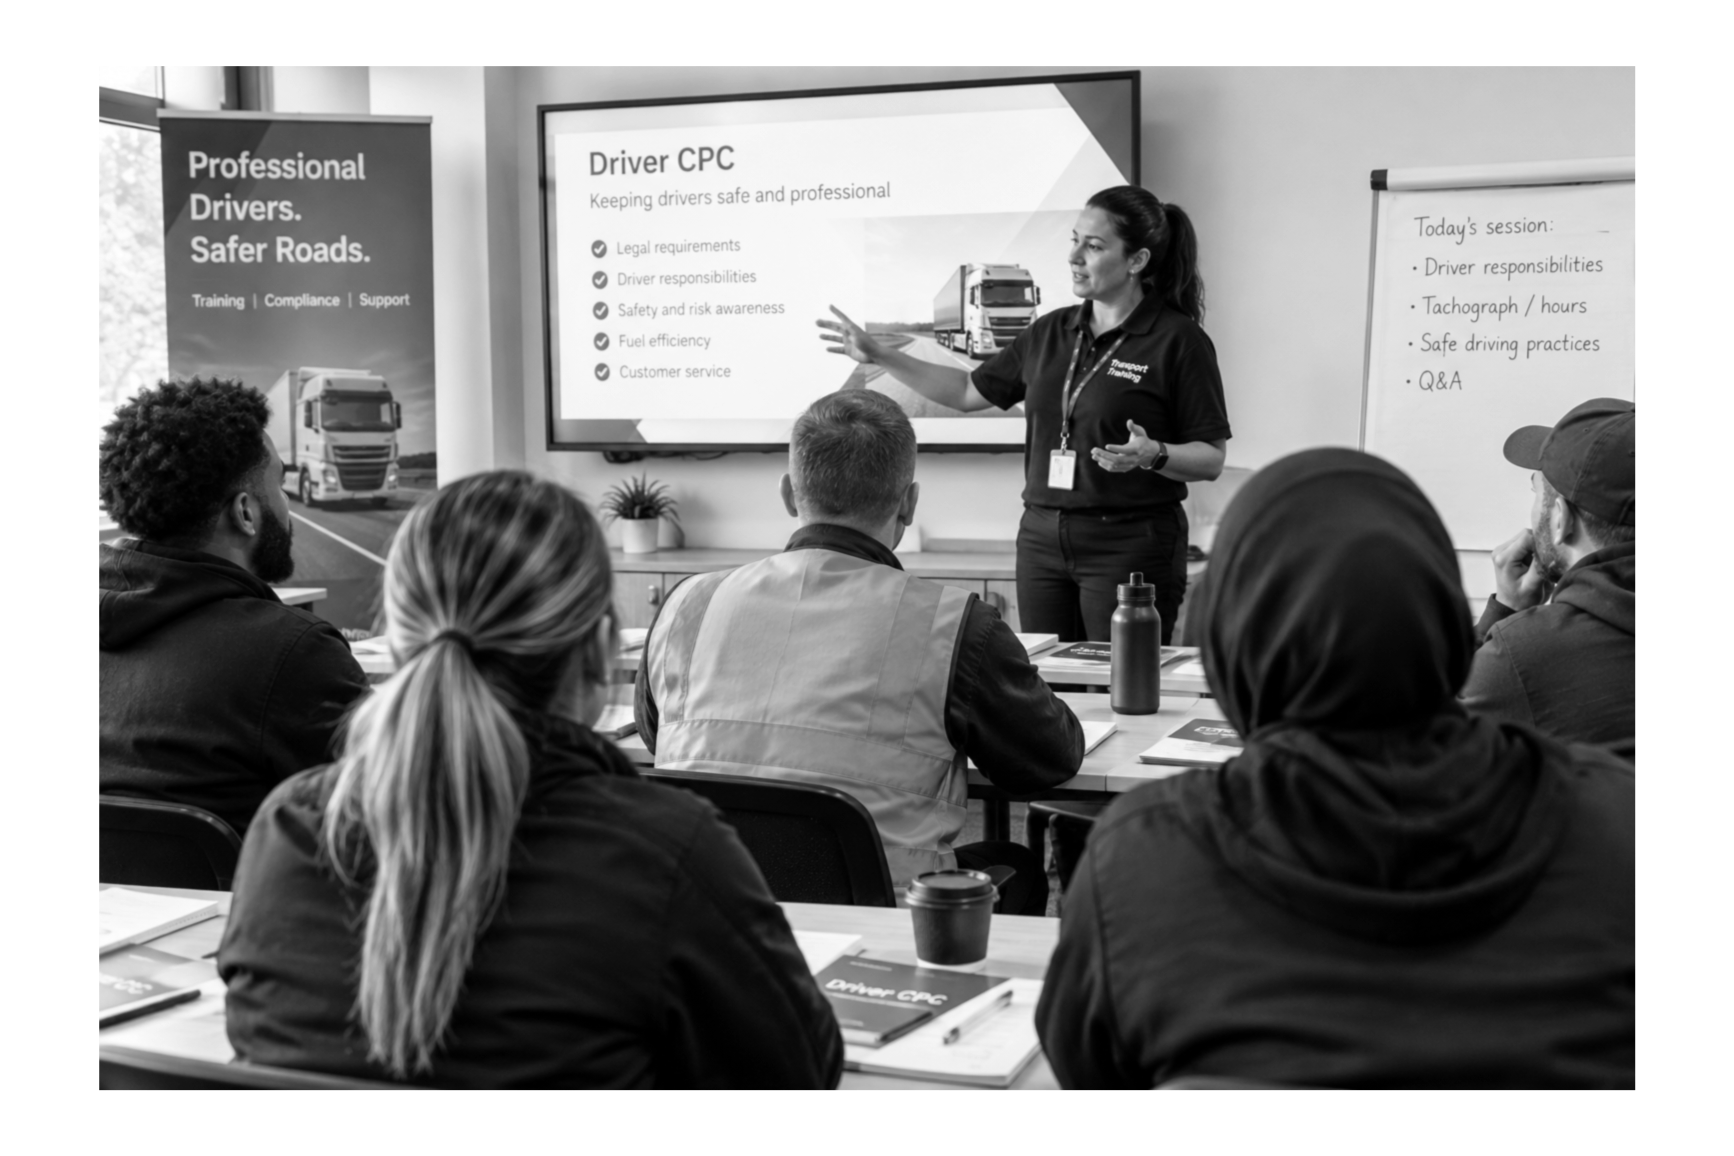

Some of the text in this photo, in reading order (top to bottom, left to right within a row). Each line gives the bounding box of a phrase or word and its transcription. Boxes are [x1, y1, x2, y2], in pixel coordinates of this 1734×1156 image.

[189, 151, 365, 180] Professional
[590, 145, 734, 175] Driver CPC
[190, 193, 301, 221] Drivers.
[590, 181, 890, 211] Keeping drivers safe and professional
[1414, 216, 1553, 245] Today's session:
[191, 235, 370, 263] Safer Roads.
[617, 239, 741, 258] Legal requirements
[618, 270, 756, 287] Driver responsibilities
[1425, 255, 1603, 281] Driver responsibilities
[192, 293, 410, 310] Training Compliance Support
[618, 302, 785, 319] Safety and risk awareness
[1422, 294, 1587, 323] Tachograph / hours
[619, 333, 711, 350] Fuel efficiency
[1421, 332, 1600, 360] Safe driving practices
[620, 365, 731, 378] Customer service
[1419, 370, 1462, 392] Q&A
[826, 979, 947, 1005] Driver CPC
